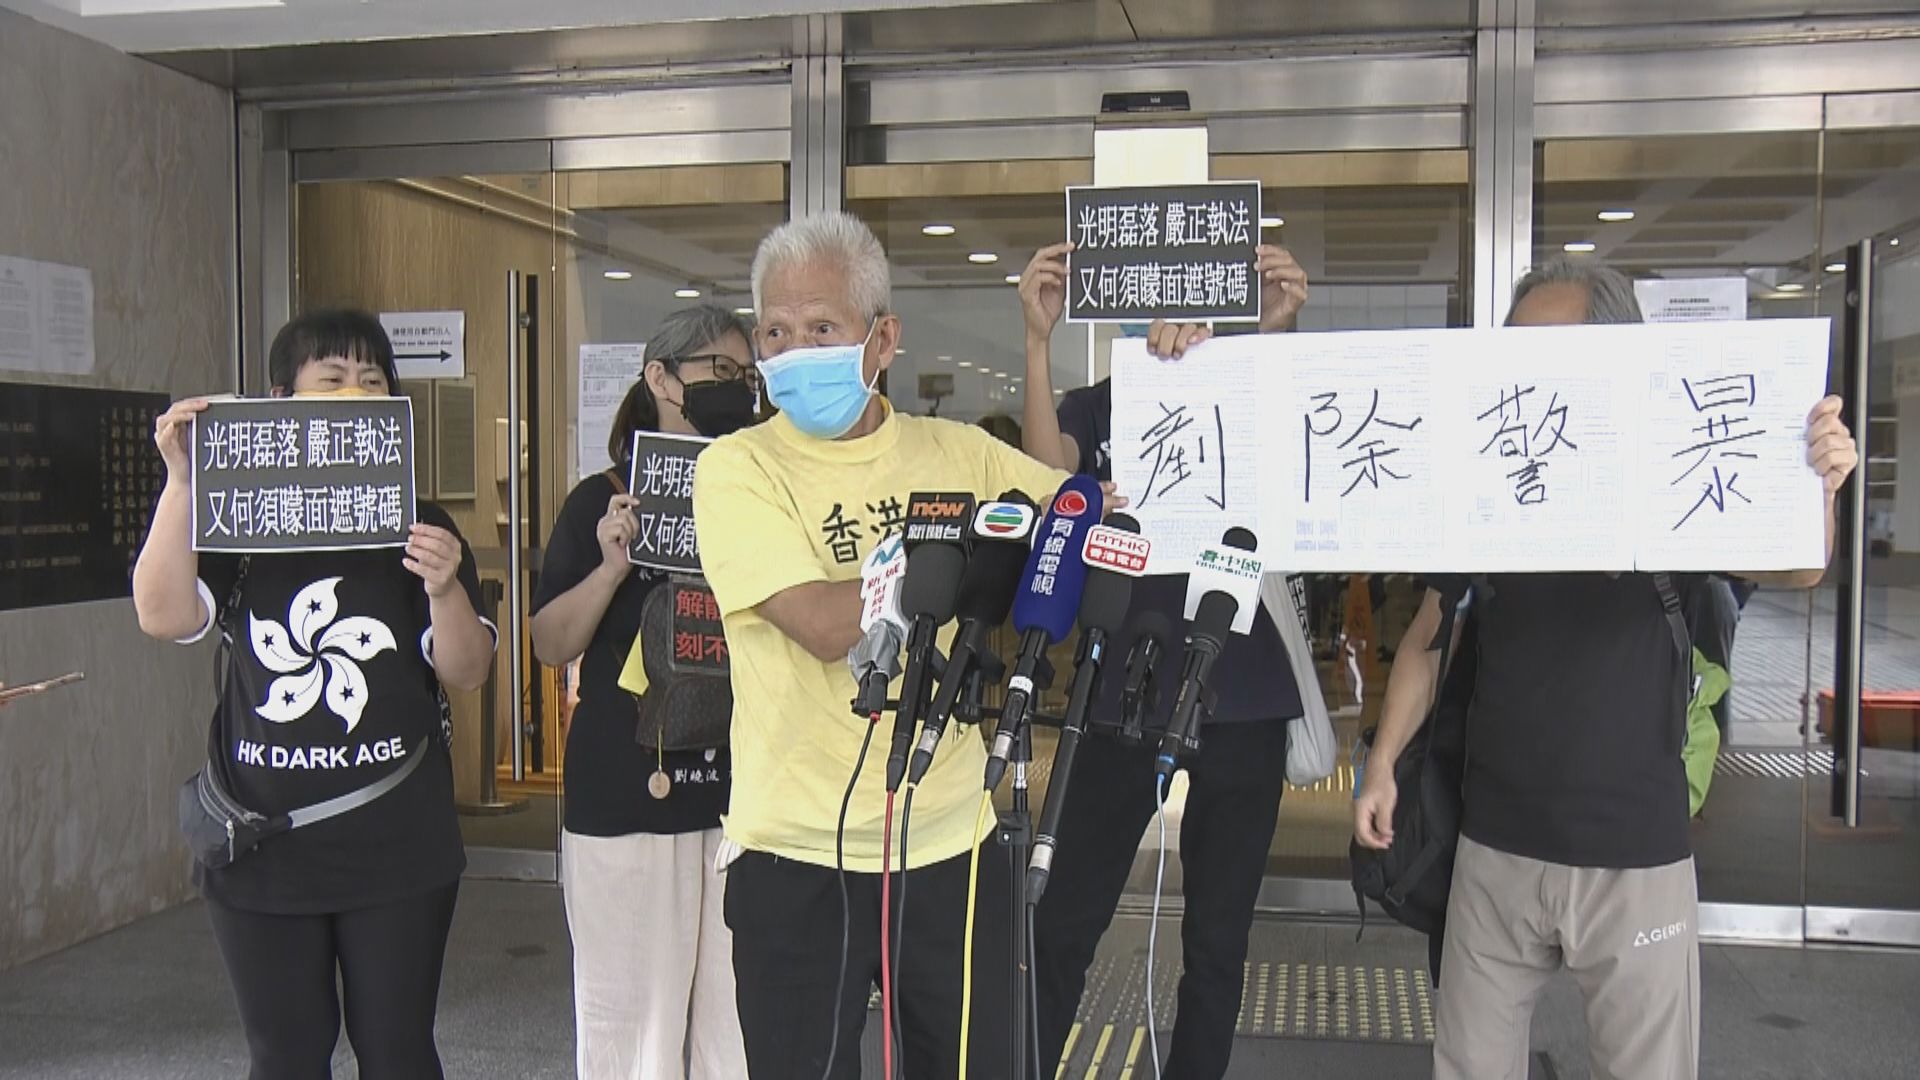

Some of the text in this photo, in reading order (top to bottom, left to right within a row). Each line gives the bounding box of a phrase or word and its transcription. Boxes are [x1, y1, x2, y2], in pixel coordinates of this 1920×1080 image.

[1077, 200, 1250, 250] 光明磊落 嚴正執法
[204, 418, 300, 471] 光明磊落
[306, 416, 402, 468] 嚴正執法
[911, 501, 966, 518] now
[1031, 518, 1075, 596] 有線電視
[238, 737, 406, 769] HK DARK AGE
